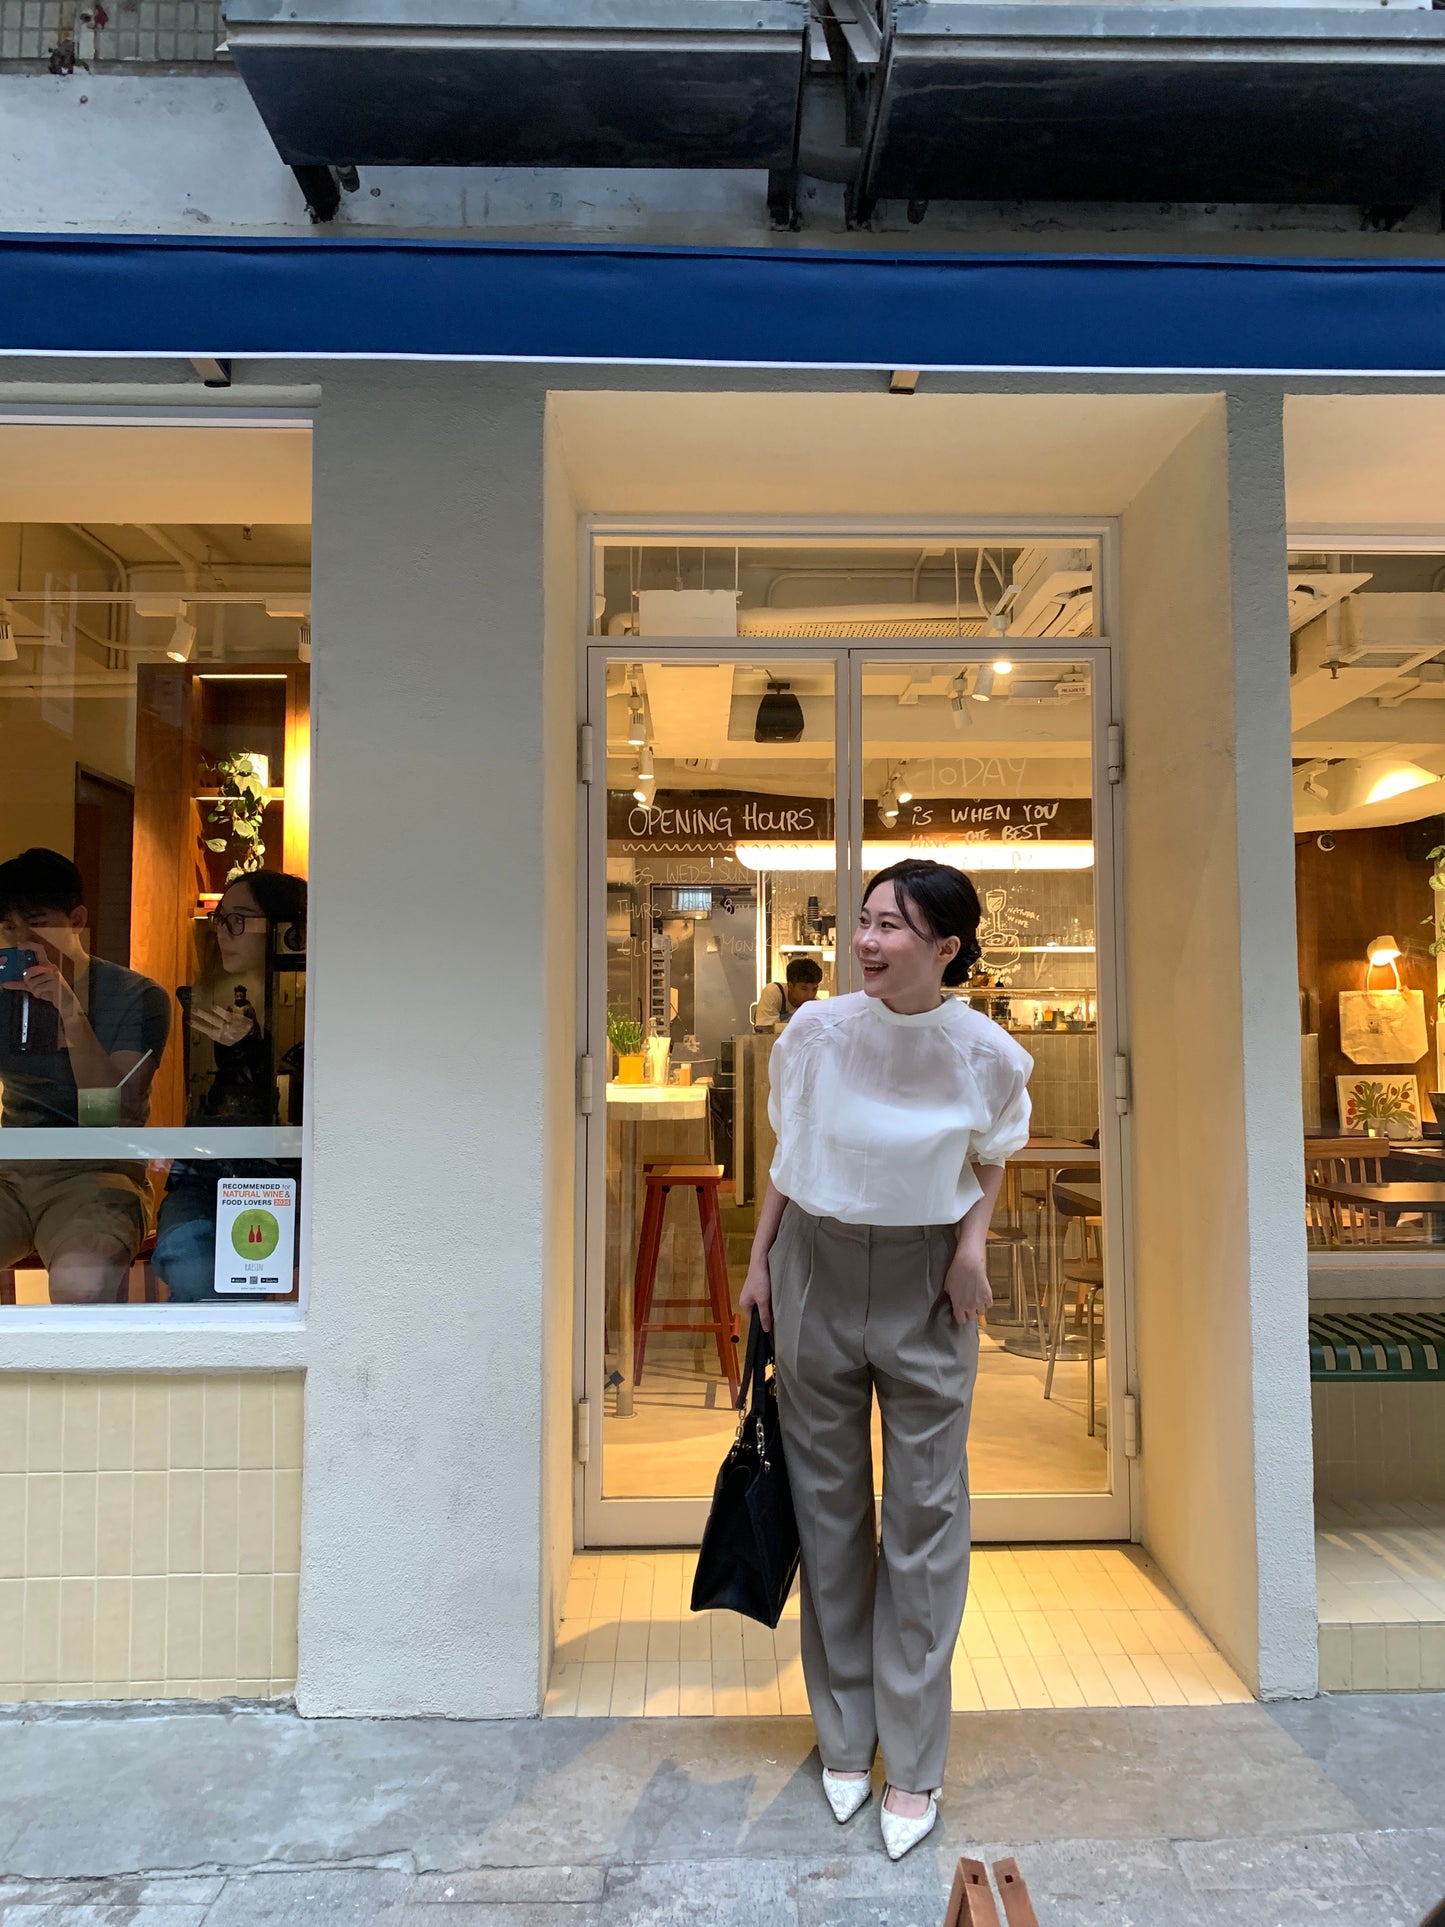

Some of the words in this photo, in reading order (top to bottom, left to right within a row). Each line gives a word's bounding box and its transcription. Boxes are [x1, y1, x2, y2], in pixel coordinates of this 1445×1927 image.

[951, 804, 1011, 824] WHEN
[1023, 802, 1060, 823] YOU
[1001, 822, 1049, 845] BEST
[1006, 915, 1030, 929] WINE
[223, 1190, 260, 1198] NATURAL
[263, 1190, 284, 1198] WINE
[284, 1190, 290, 1198] &
